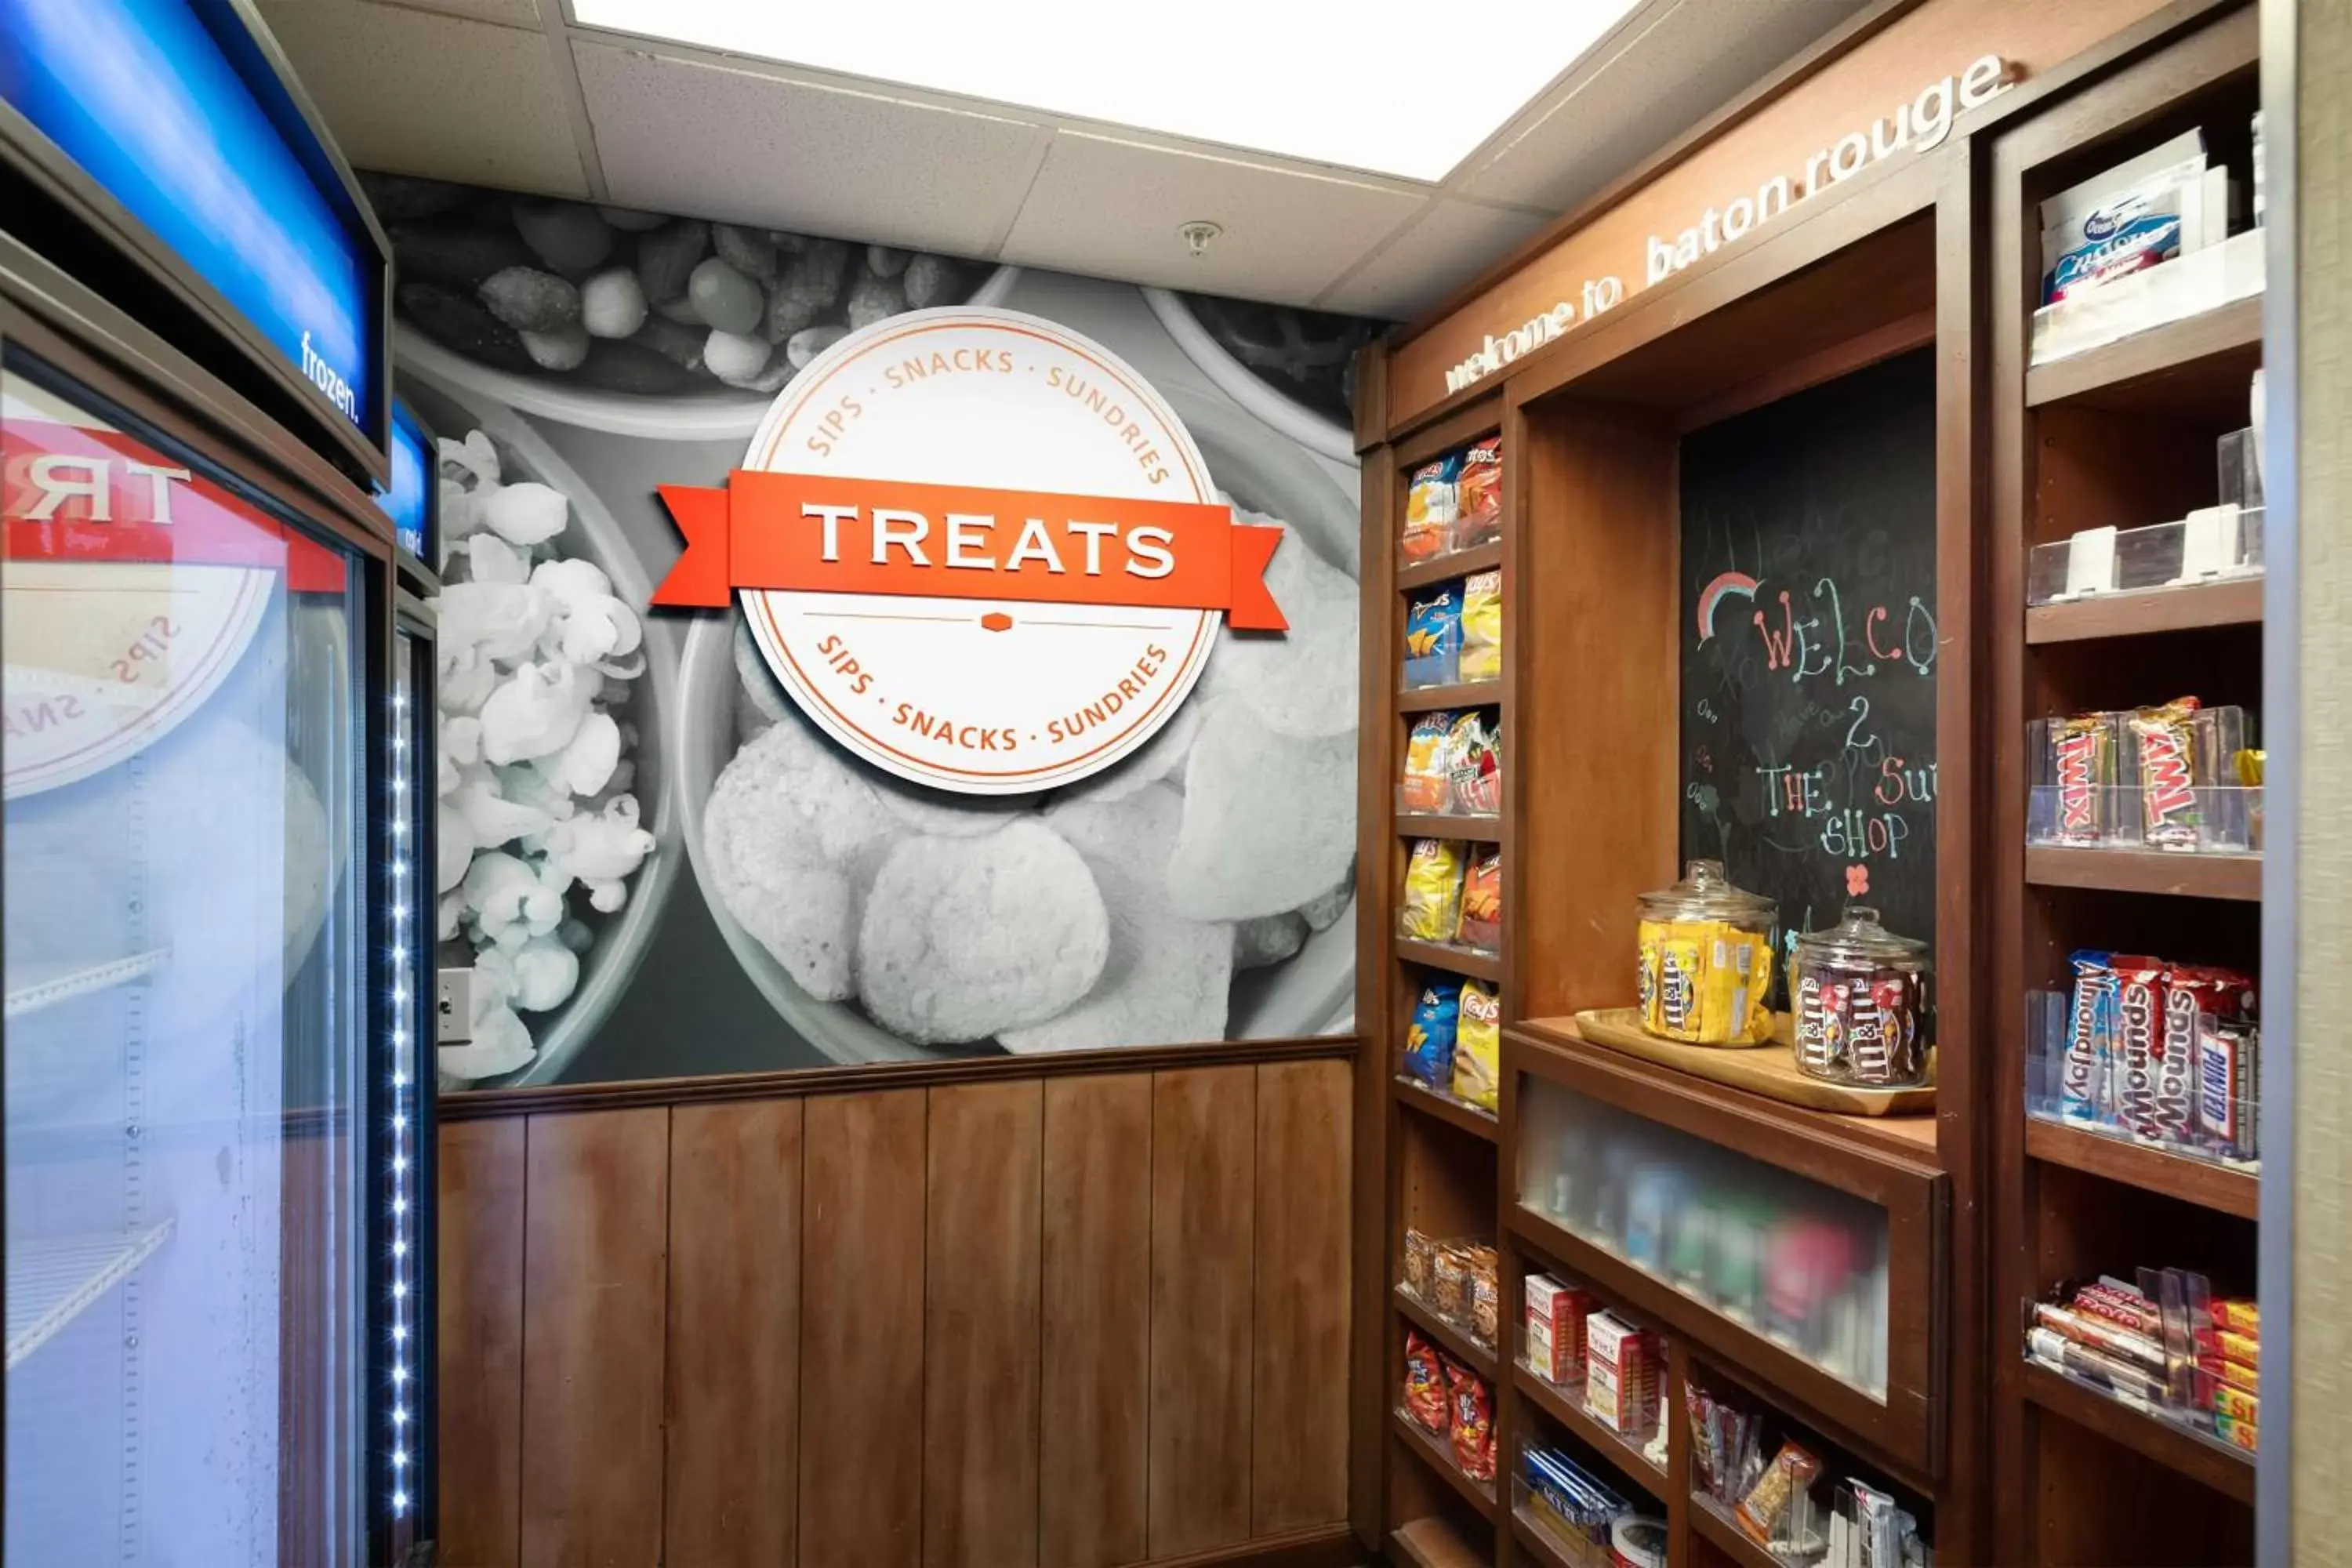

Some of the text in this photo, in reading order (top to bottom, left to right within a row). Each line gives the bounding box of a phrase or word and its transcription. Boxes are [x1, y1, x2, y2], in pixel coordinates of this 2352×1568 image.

[1445, 301, 1575, 395] welcome
[1581, 276, 1624, 320] to
[1646, 173, 1791, 287] baton
[300, 330, 358, 424] frozen.
[806, 348, 1169, 485] SIPS SNACKS SUNDRIES
[801, 501, 1176, 579] TREATS
[817, 634, 1168, 751] SIPS SNACKS SUNDRIES
[1846, 695, 1878, 748] 2
[1755, 763, 1833, 817] THE
[1820, 808, 1909, 858] SHOP
[2120, 982, 2162, 1141] Mounds
[2156, 988, 2196, 1129] Mounds
